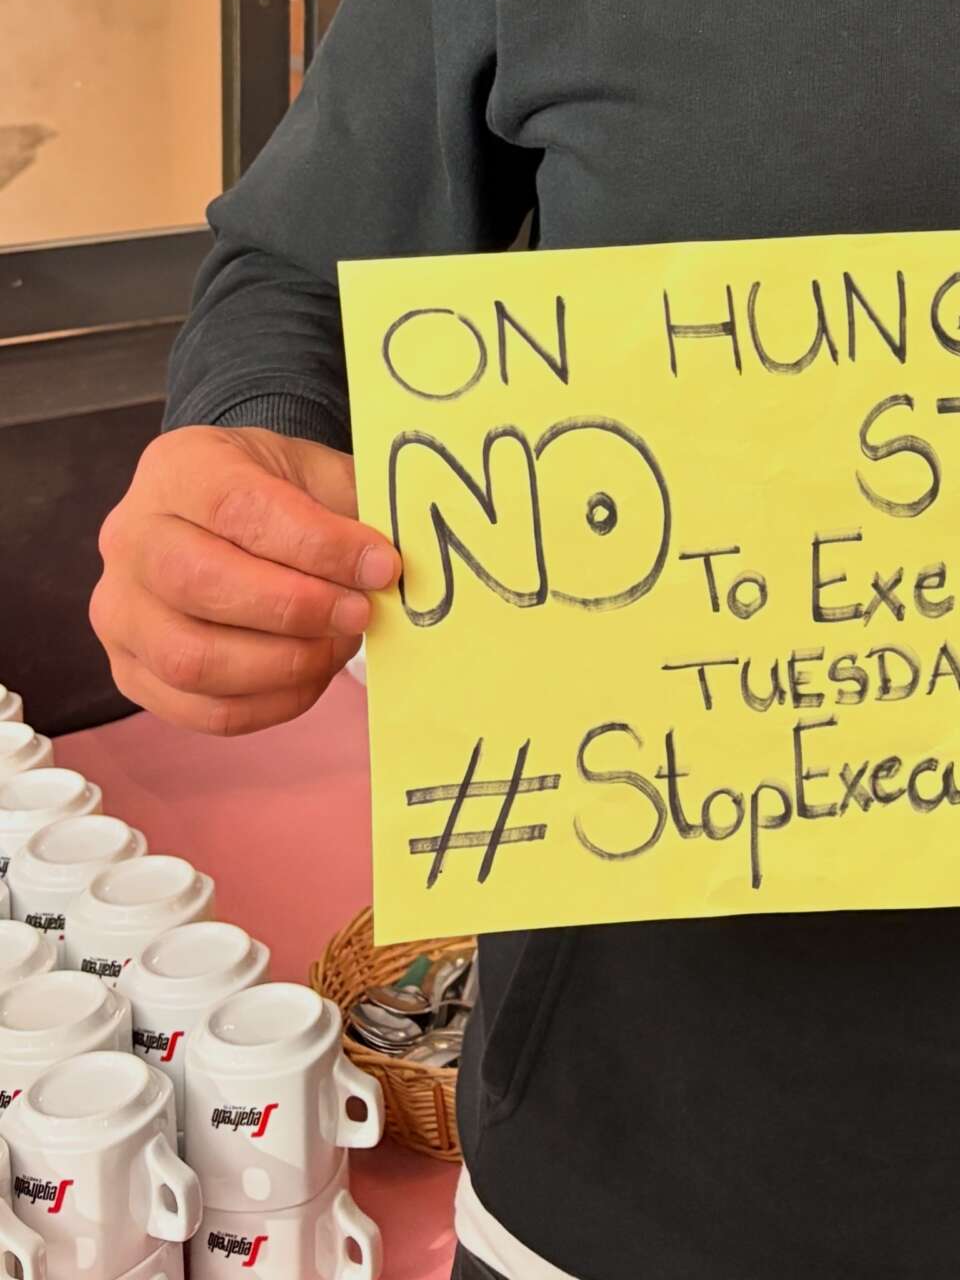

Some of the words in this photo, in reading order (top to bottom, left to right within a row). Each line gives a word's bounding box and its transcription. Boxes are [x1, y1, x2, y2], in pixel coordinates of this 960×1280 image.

[382, 295, 569, 401] ON
[388, 416, 673, 628] NO
[677, 545, 769, 621] To
[211, 1103, 279, 1138] Segafredo
